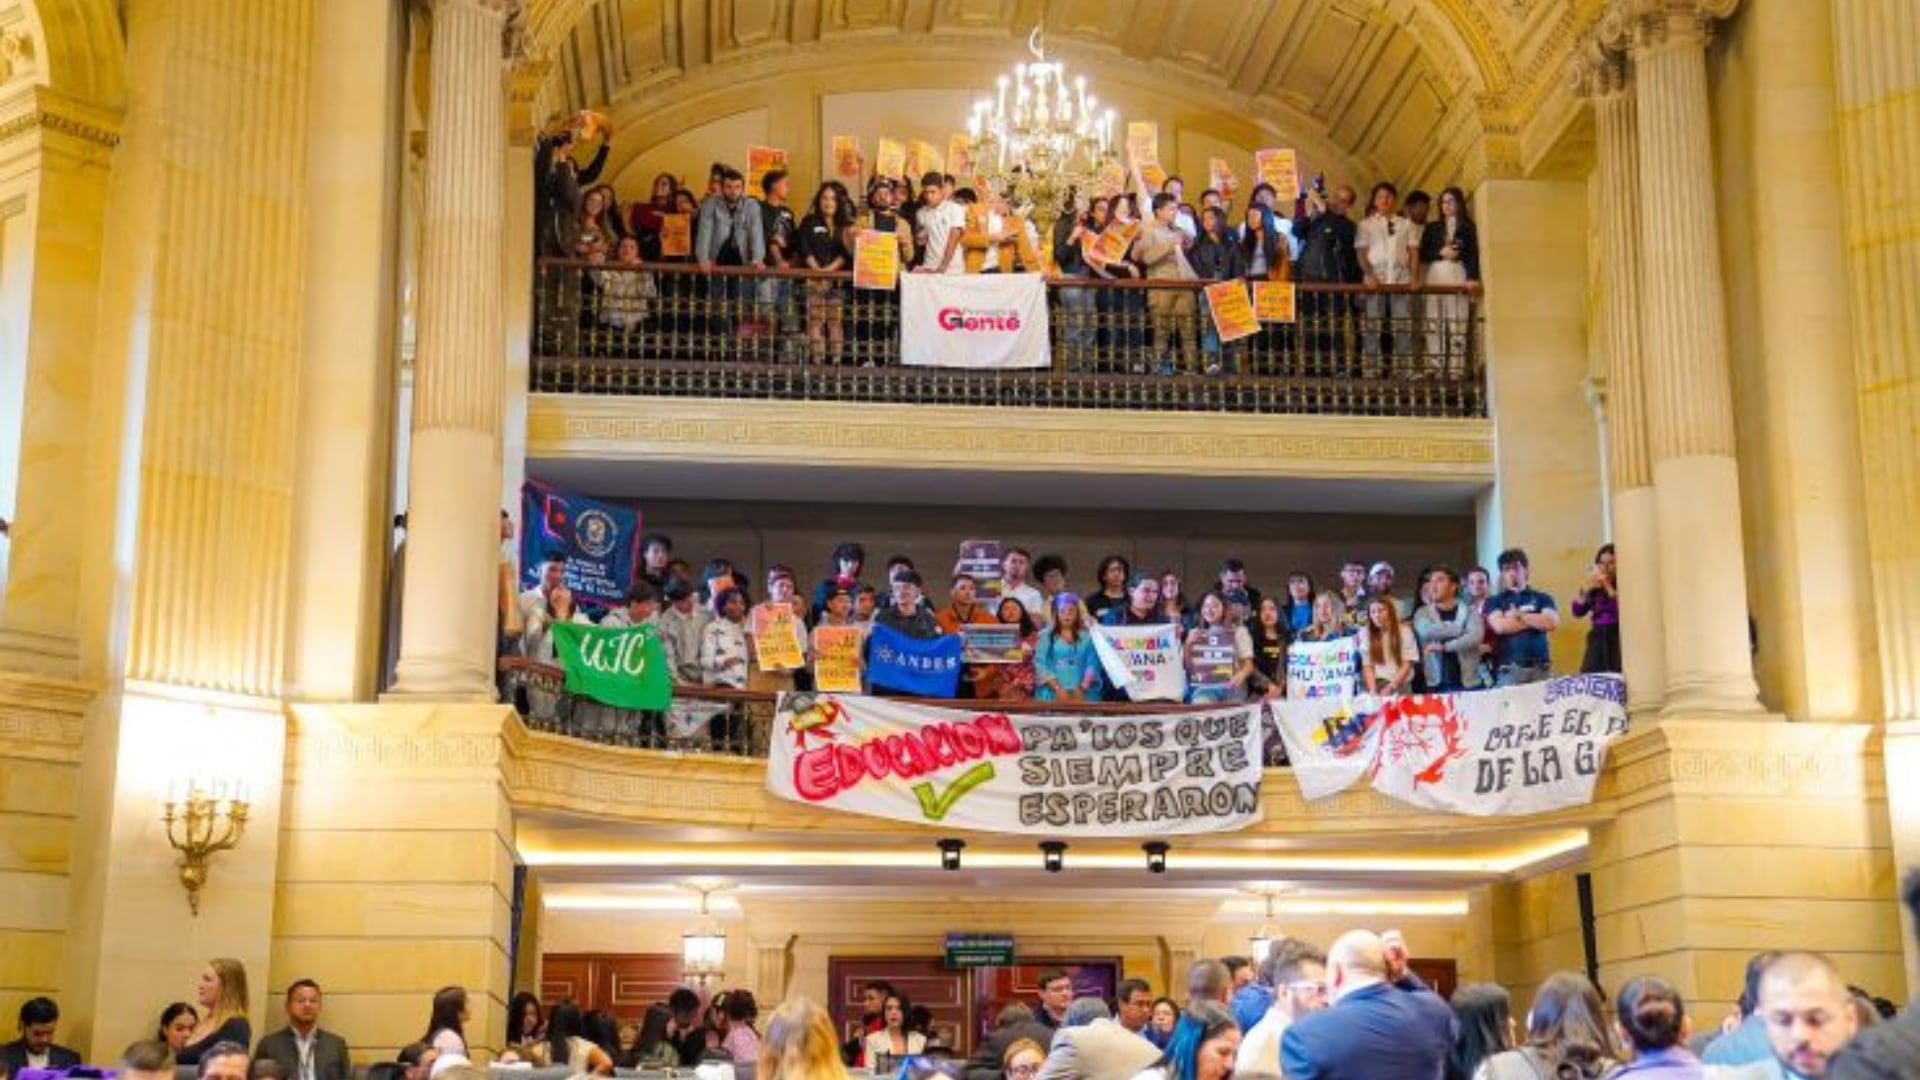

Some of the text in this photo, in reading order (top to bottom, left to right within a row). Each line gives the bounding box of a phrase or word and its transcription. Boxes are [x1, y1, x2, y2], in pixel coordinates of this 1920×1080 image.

[1174, 711, 1251, 747] QUE
[793, 710, 1021, 801] EDUCACION
[1018, 740, 1250, 789] SIEMPRE
[1522, 744, 1563, 787] LA
[1574, 740, 1596, 775] G
[1018, 781, 1262, 826] ESPERARON
